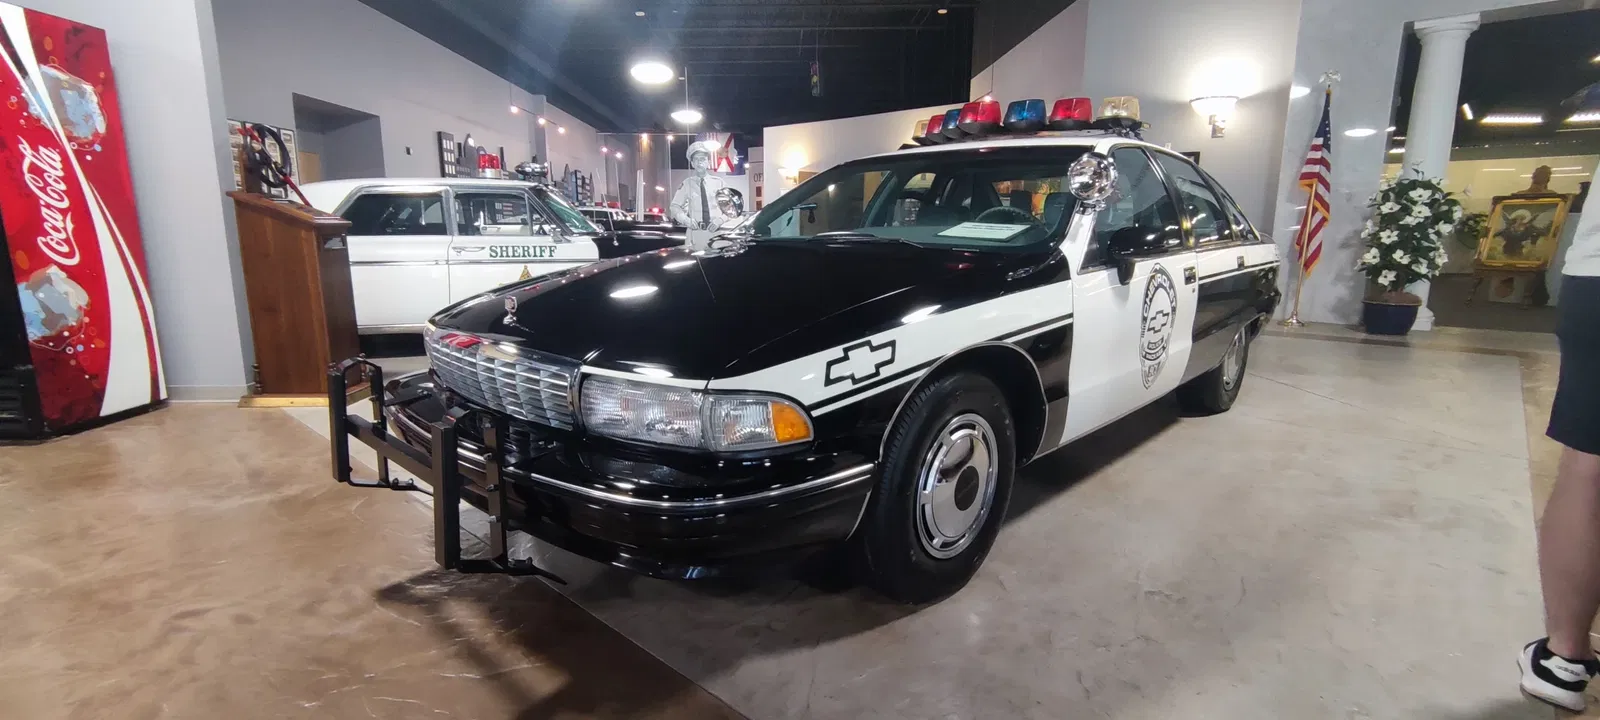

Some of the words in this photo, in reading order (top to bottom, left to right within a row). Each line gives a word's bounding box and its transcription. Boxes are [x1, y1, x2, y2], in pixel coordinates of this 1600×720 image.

[17, 134, 80, 266] Coca-Cola
[489, 245, 557, 258] SHERIFF
[1143, 272, 1177, 318] CHEVROLET
